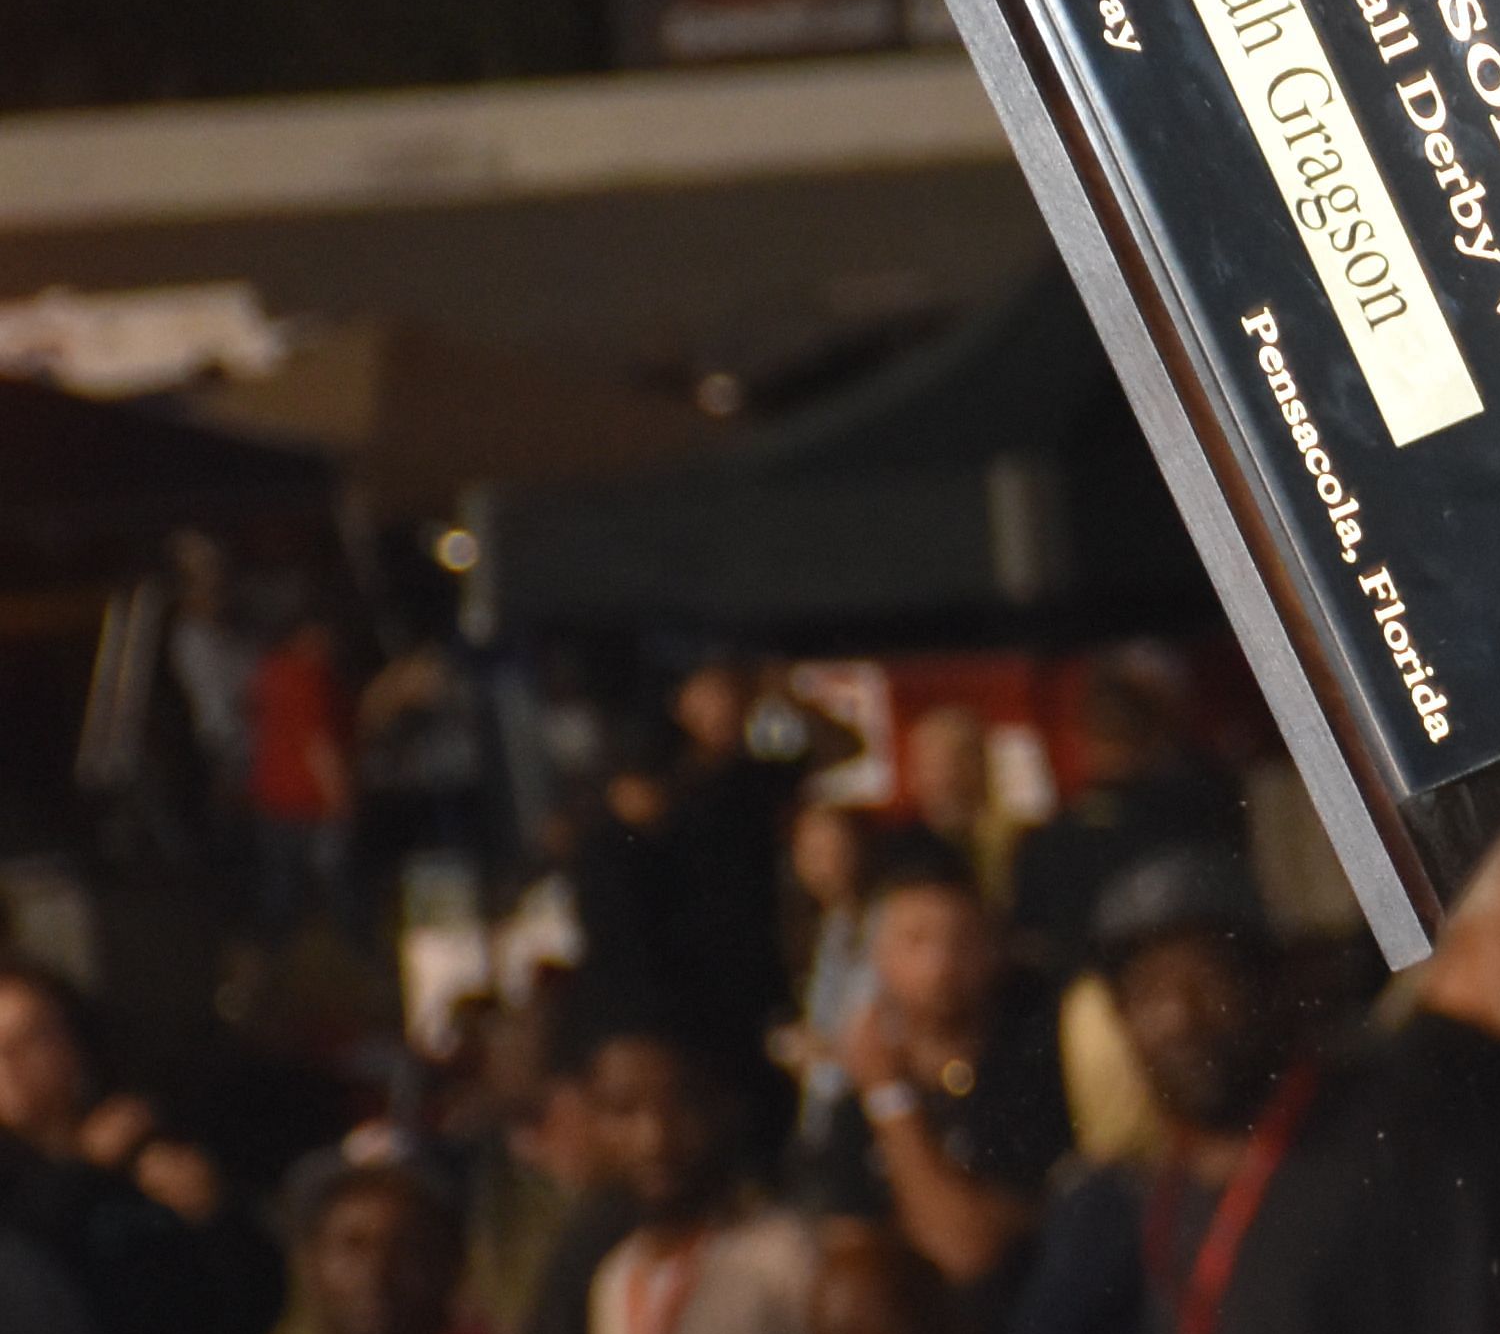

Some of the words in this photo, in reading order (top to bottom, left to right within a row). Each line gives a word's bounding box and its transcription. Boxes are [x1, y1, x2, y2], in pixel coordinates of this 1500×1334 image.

[1266, 67, 1409, 333] Gragson
[1241, 307, 1364, 564] Pensacola,
[1358, 566, 1451, 743] Florida
